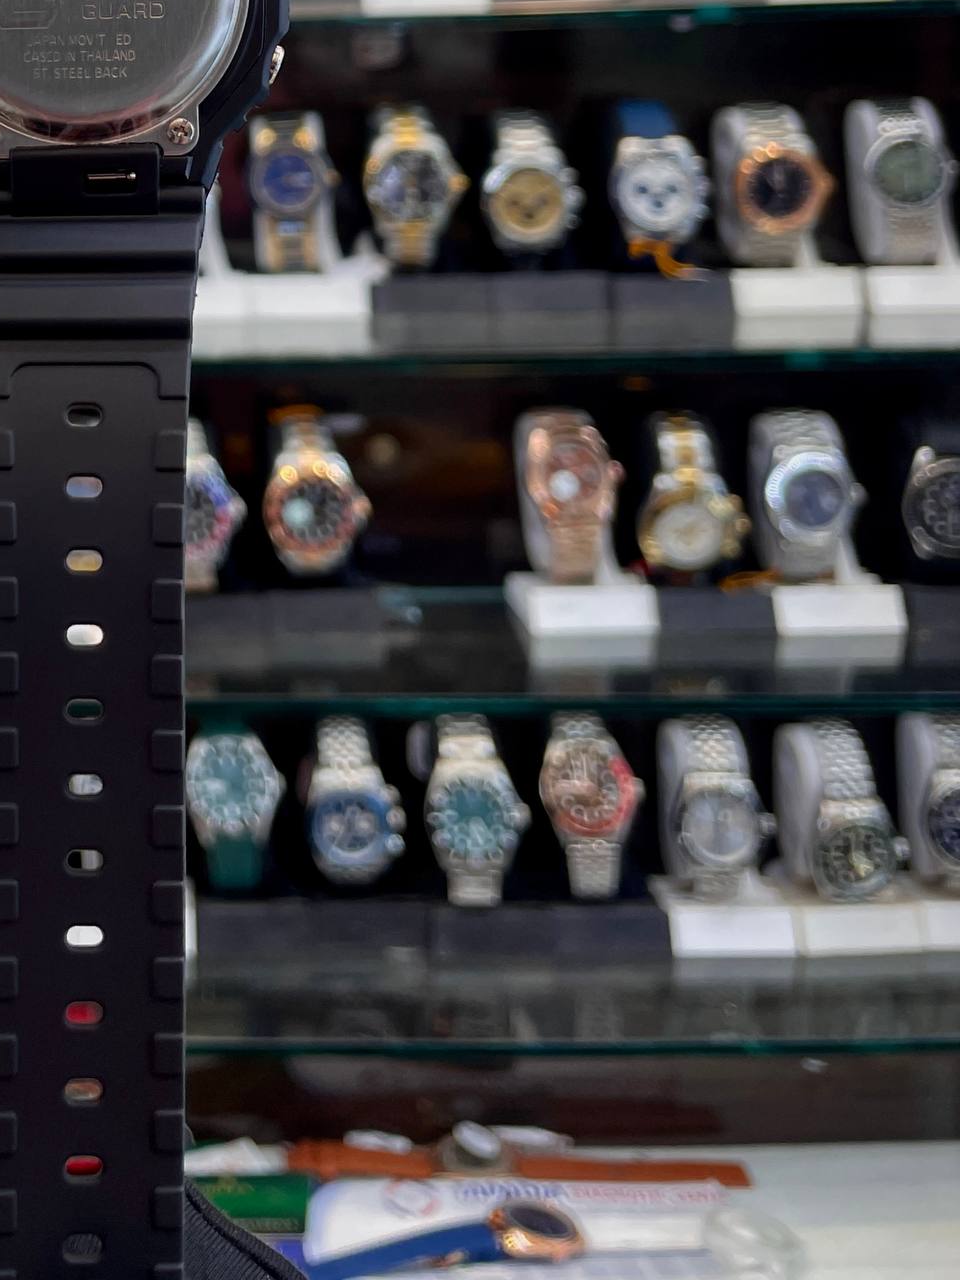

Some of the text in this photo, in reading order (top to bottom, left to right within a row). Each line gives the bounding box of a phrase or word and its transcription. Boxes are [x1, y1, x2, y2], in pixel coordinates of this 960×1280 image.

[81, 1, 166, 20] GUARD
[115, 33, 132, 46] ED
[80, 49, 137, 62] THAILAND
[54, 67, 91, 79] STEEL
[95, 66, 128, 79] BACK
